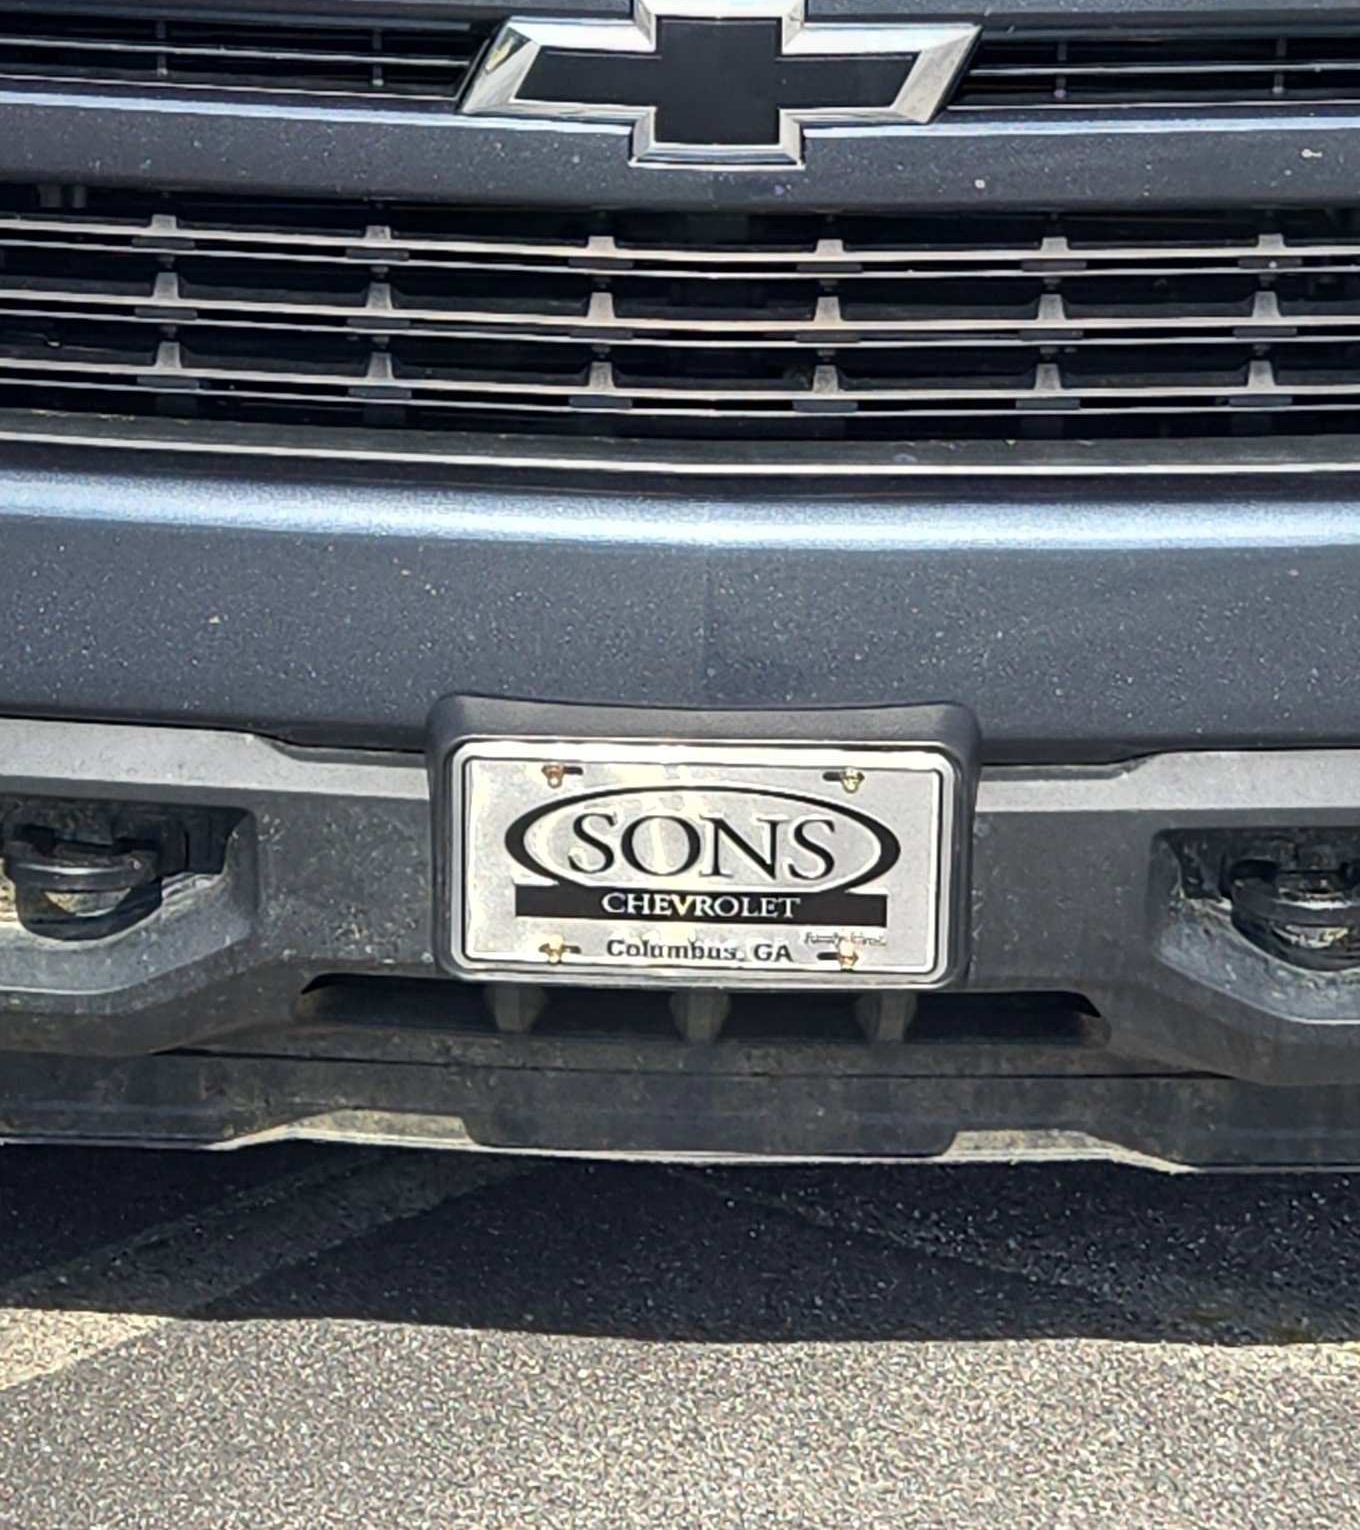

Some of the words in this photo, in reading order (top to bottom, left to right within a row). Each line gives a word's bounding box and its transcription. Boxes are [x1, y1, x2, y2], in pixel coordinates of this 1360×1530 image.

[567, 812, 837, 881] SONS
[601, 891, 801, 918] CHEVROLET
[753, 942, 794, 963] GA
